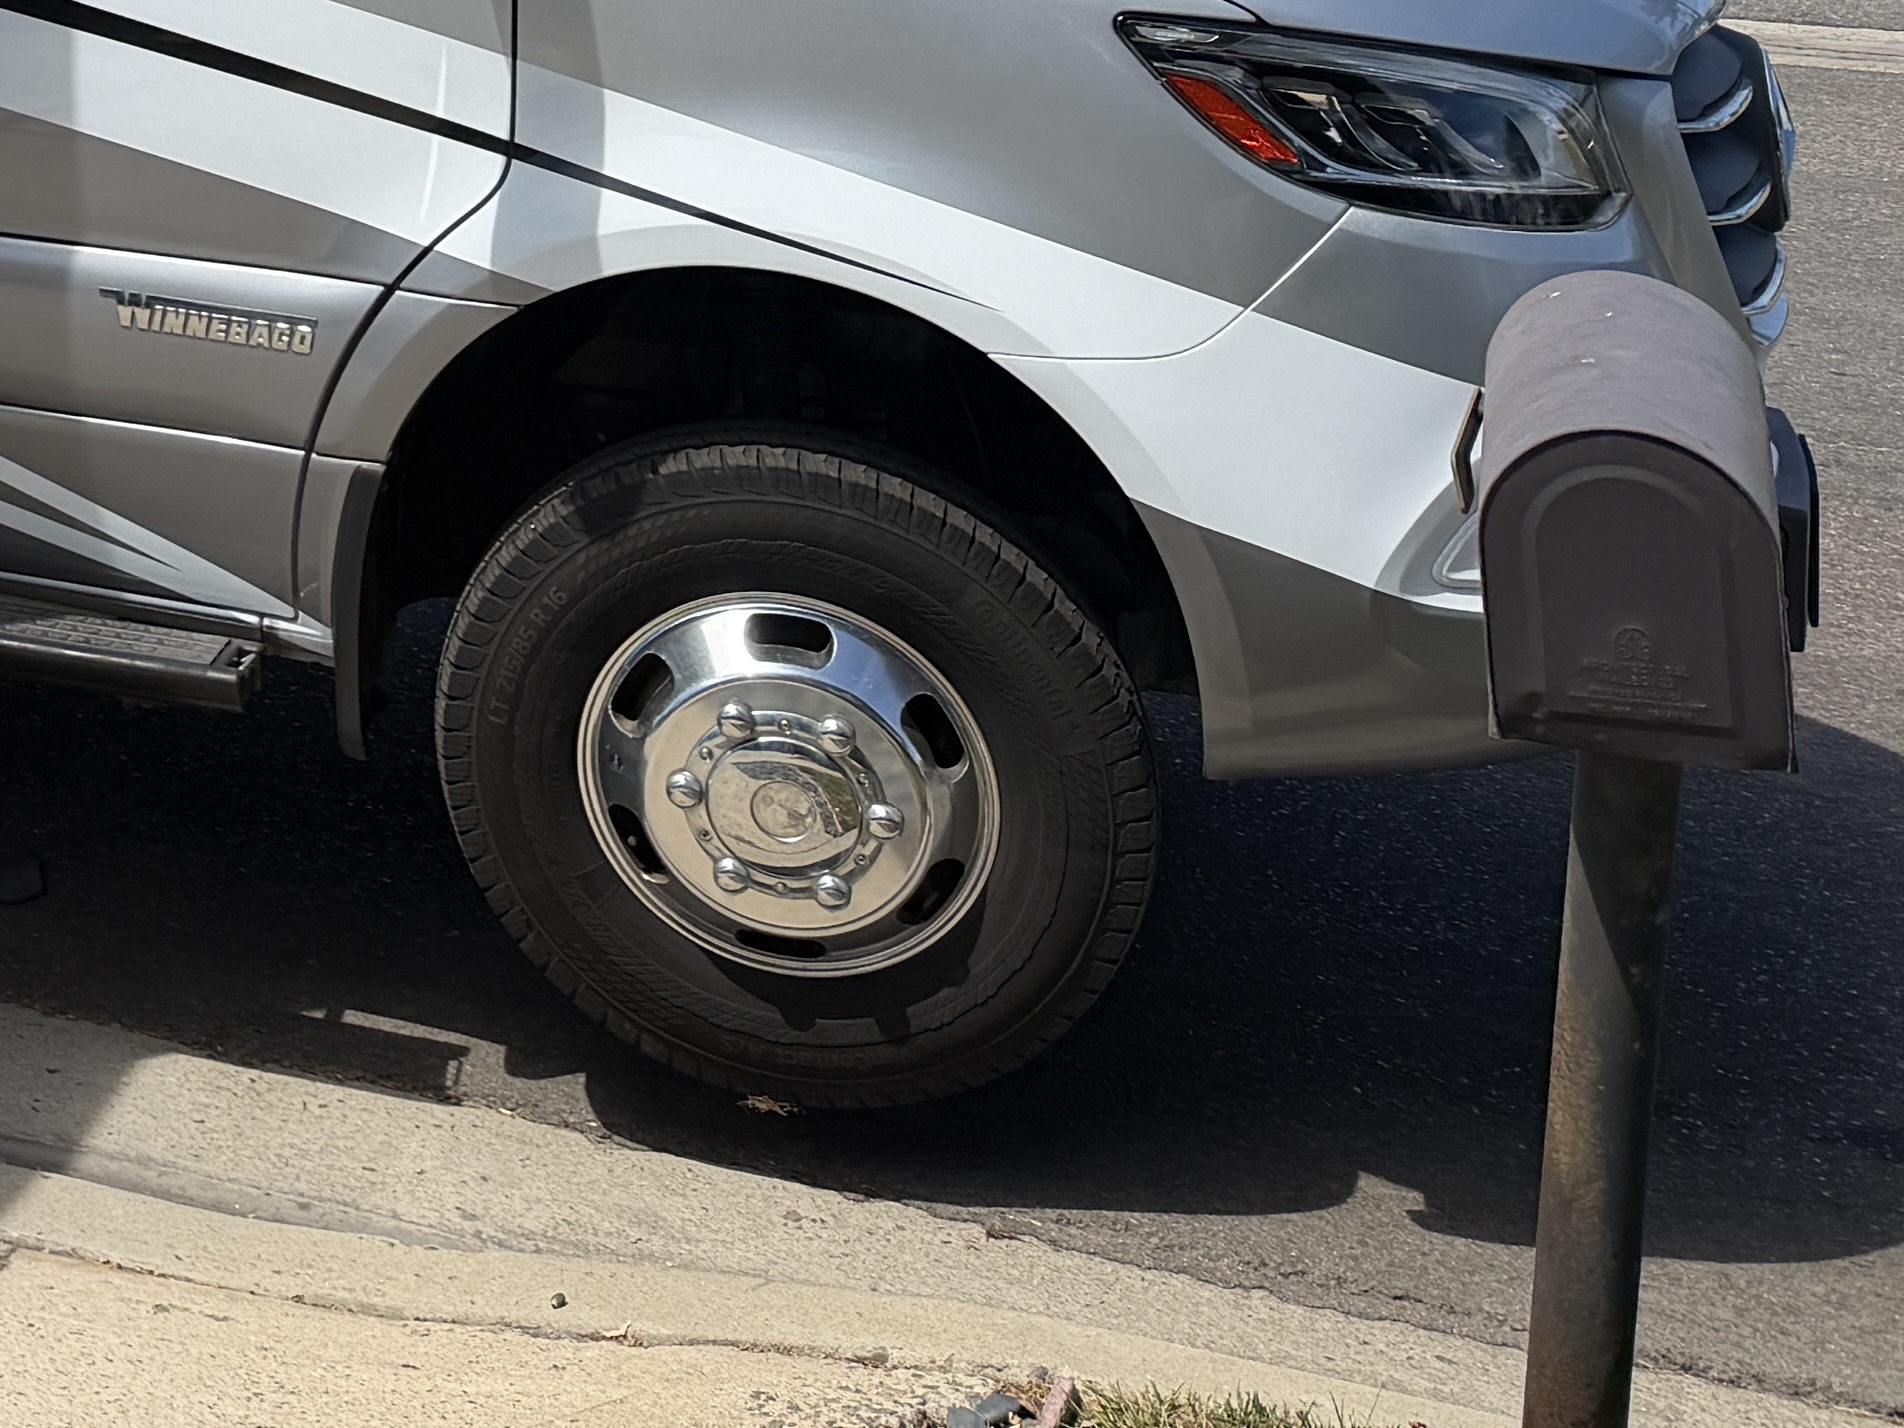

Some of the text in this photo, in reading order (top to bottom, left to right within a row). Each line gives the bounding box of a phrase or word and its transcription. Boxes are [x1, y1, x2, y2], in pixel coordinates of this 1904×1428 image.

[98, 286, 318, 354] WINNEBAGO
[488, 586, 569, 725] LT 215/85 R 16
[974, 600, 1074, 721] Continental
